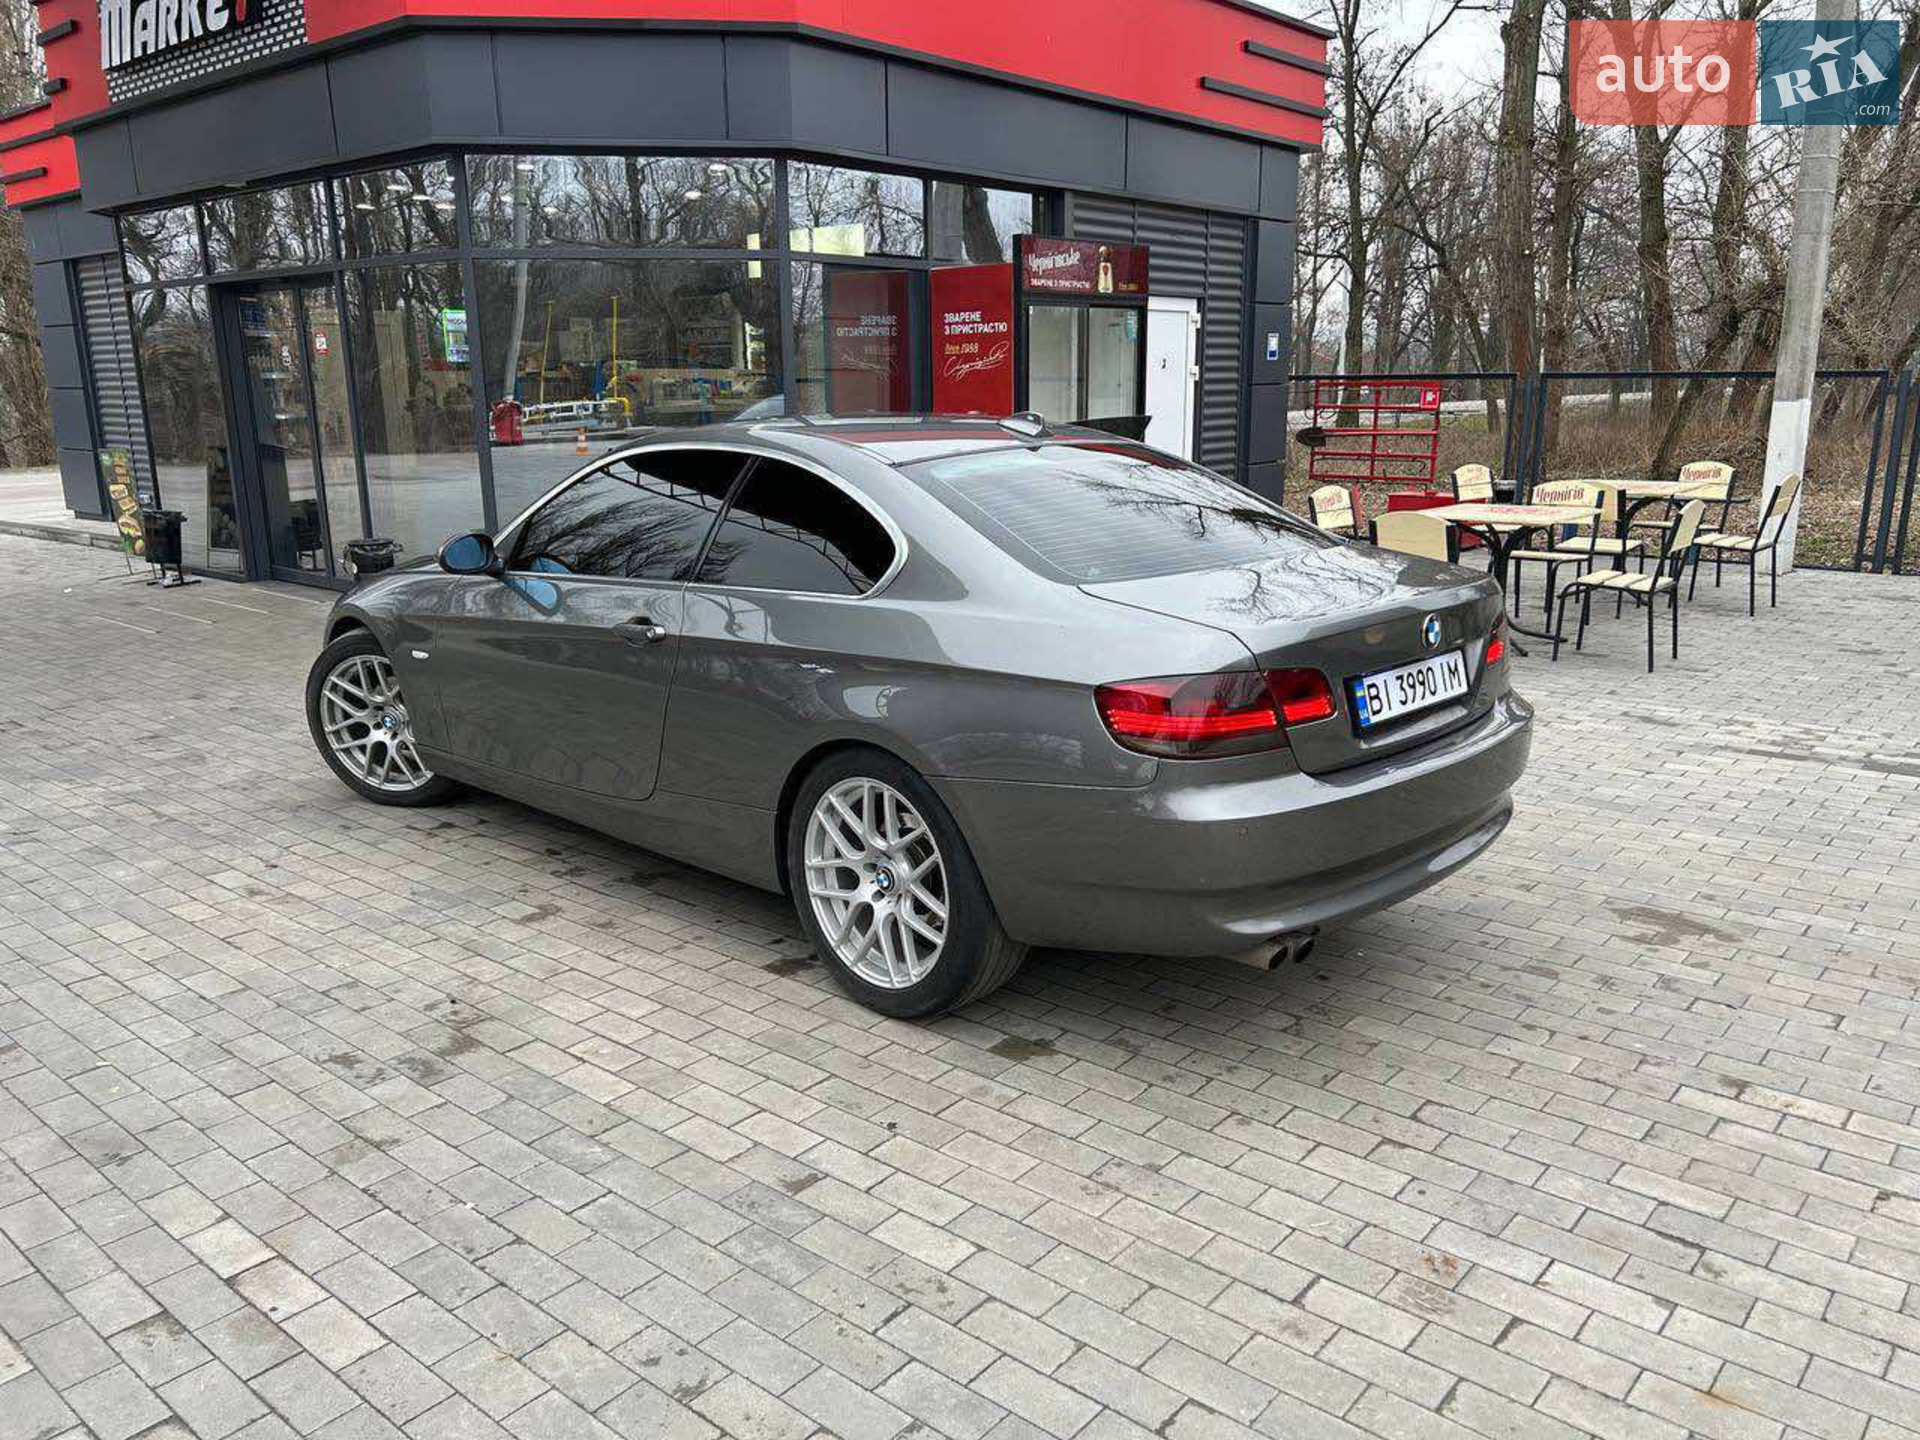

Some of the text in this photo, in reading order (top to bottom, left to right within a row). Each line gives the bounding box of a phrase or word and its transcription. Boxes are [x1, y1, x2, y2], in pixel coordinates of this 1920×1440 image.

[943, 311, 981, 322] ЗВАРЕНЕ
[944, 322, 1008, 335] З ПРИСТРАСТЮ
[1366, 659, 1462, 716] BI 3990 IM
